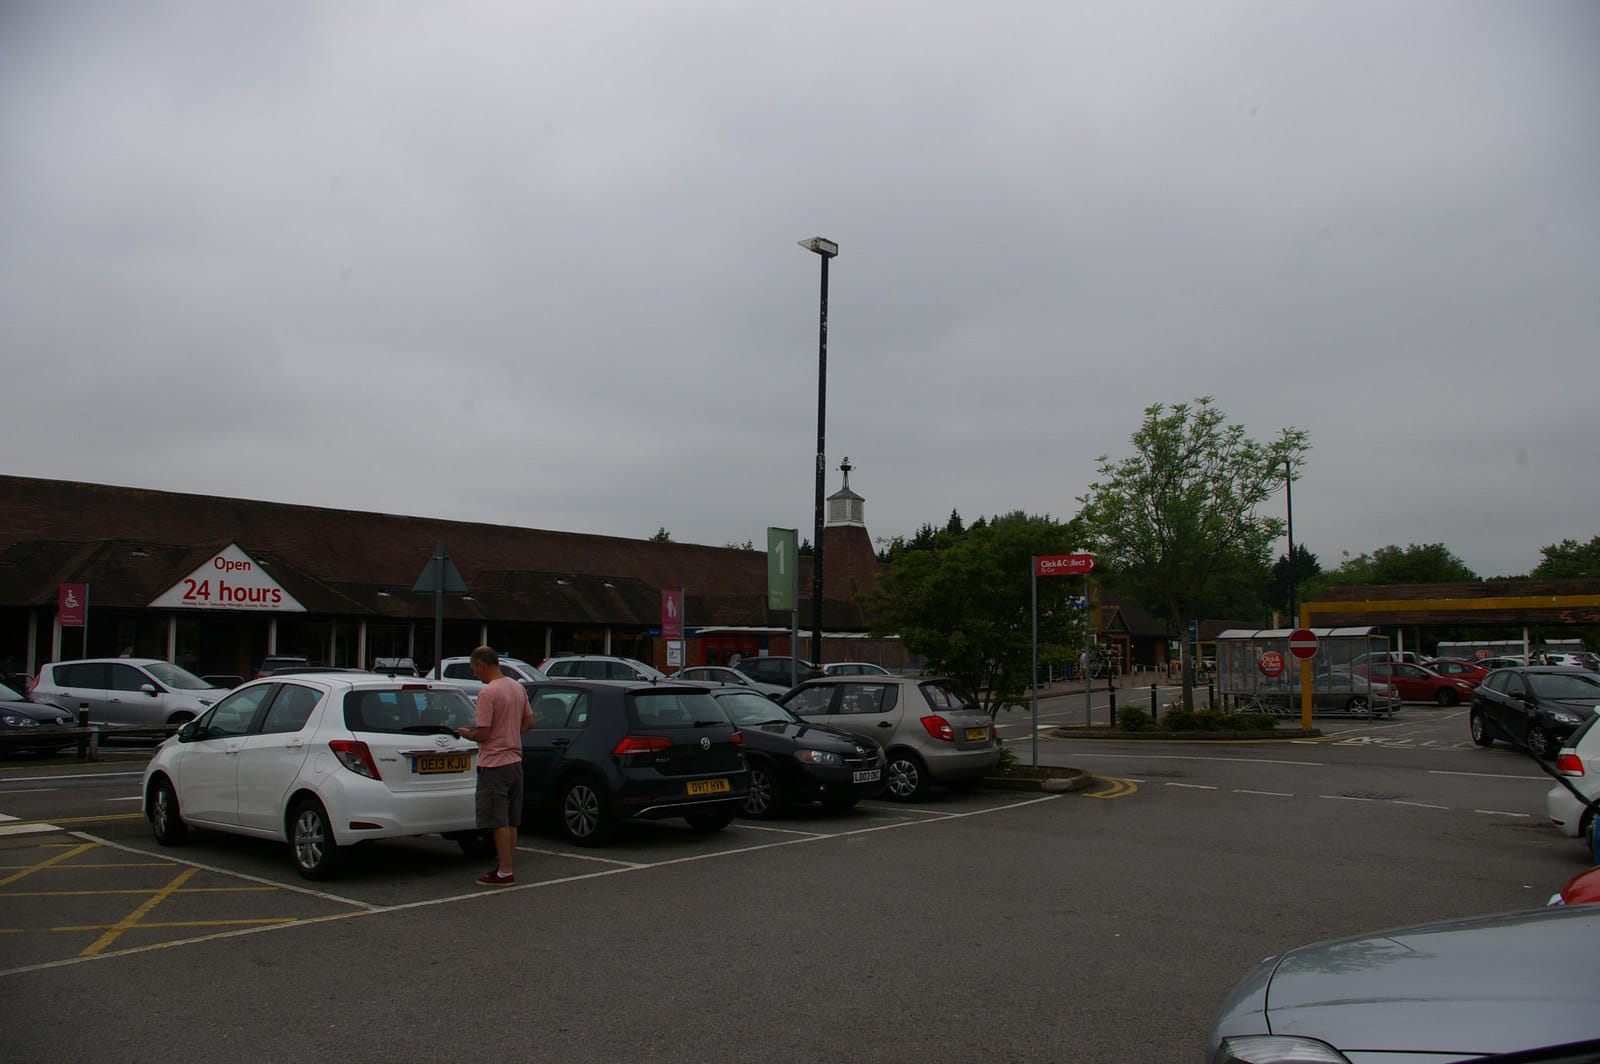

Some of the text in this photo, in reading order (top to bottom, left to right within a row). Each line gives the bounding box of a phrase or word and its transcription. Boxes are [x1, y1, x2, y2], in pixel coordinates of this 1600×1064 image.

[214, 556, 251, 573] Open
[775, 540, 784, 575] 1
[183, 578, 282, 602] 24 hours
